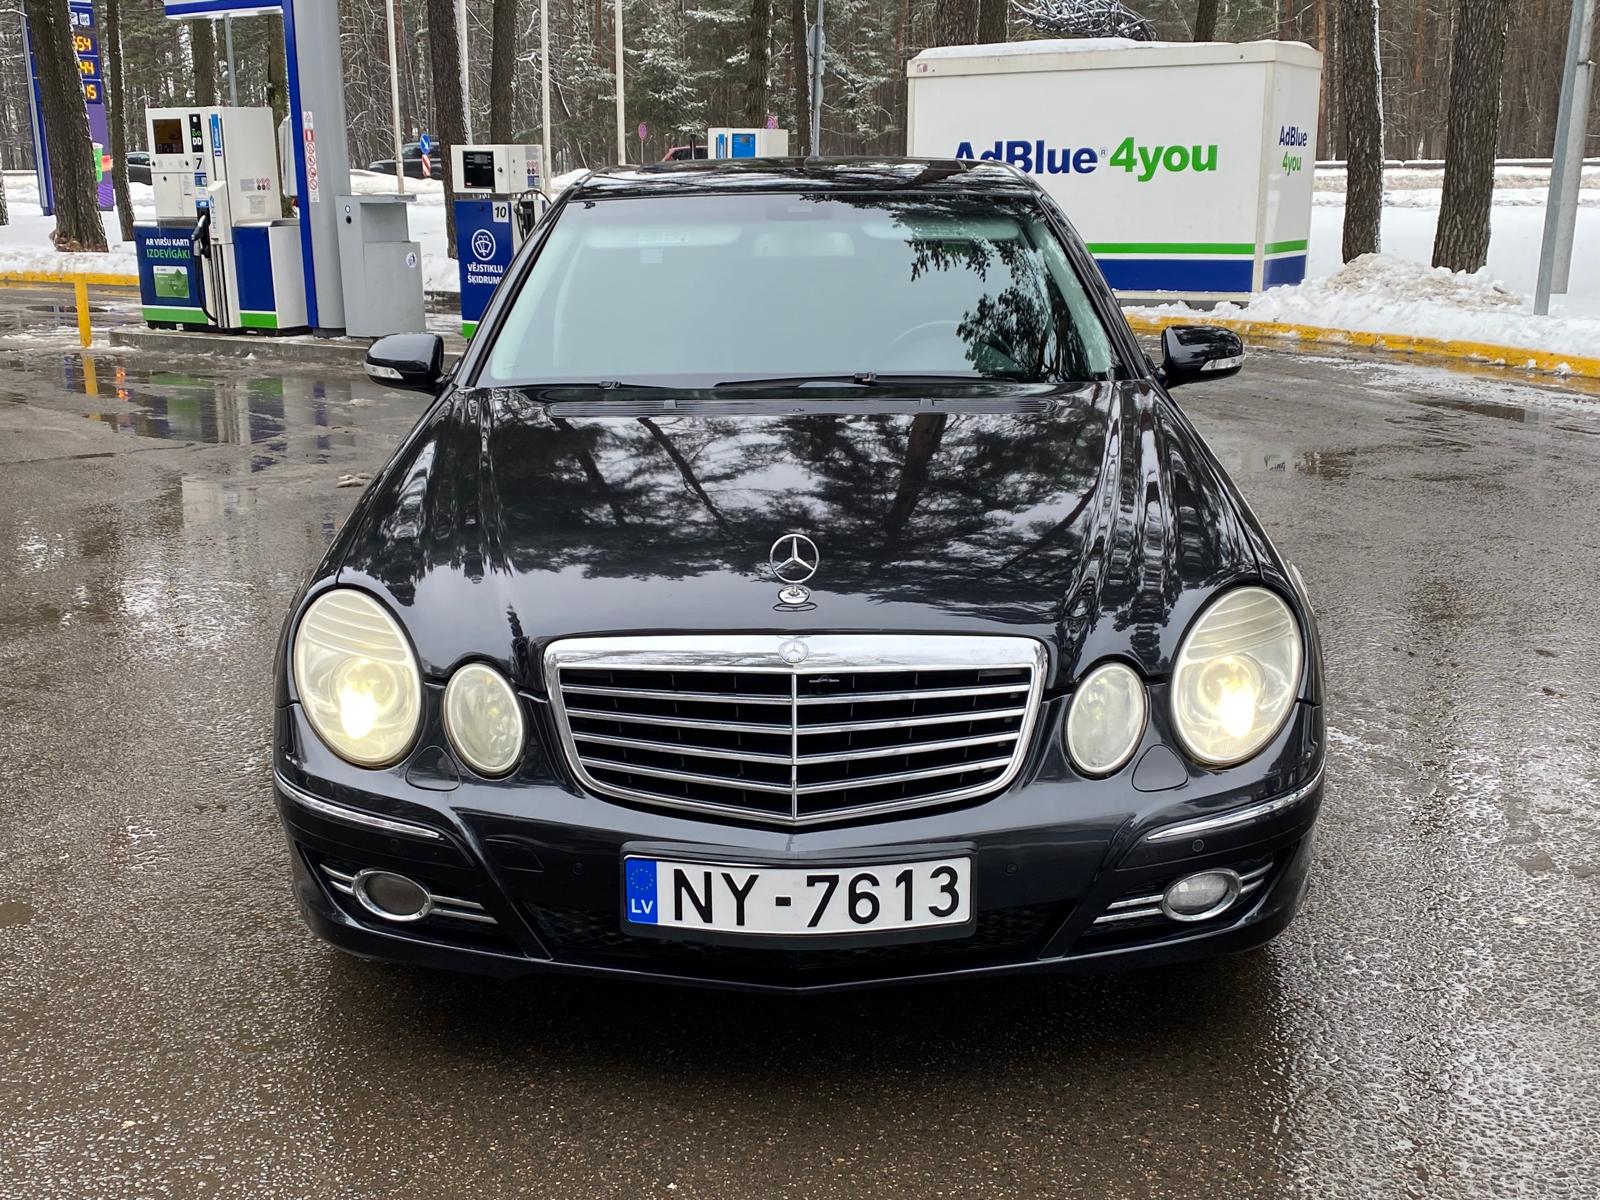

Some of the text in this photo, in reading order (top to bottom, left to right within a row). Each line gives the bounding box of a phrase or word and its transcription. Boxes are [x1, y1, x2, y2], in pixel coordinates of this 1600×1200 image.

[193, 137, 202, 145] DD
[1279, 125, 1307, 147] AdBlue
[196, 157, 202, 170] 7
[1109, 136, 1219, 183] 4you
[1282, 151, 1302, 176] 4you
[495, 206, 507, 218] 10
[145, 238, 154, 246] AR
[172, 238, 190, 247] KARTI
[467, 262, 503, 273] VĒJSTIKLU
[631, 899, 653, 915] LV
